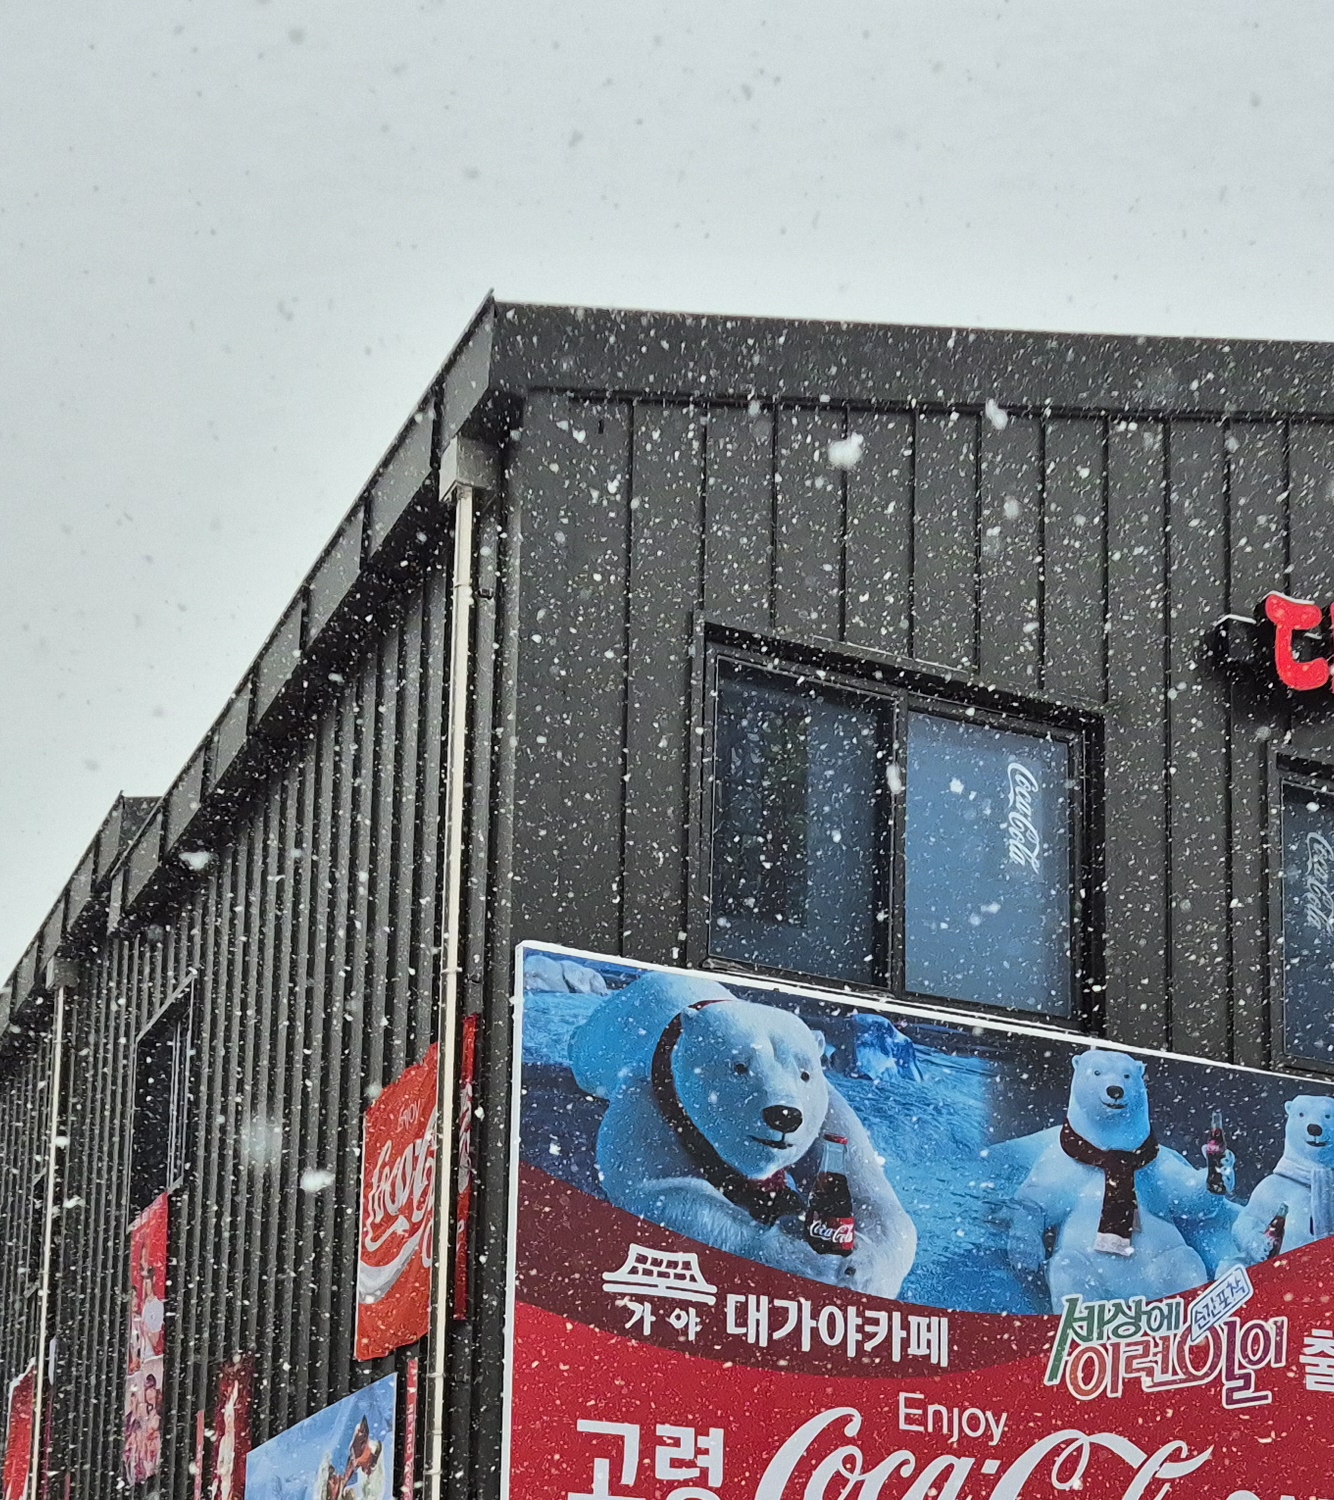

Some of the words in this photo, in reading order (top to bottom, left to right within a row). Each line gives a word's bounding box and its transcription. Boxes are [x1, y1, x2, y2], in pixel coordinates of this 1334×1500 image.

[1007, 762, 1040, 875] Coca-Cola
[1305, 831, 1334, 937] Coca-Cola
[727, 1295, 949, 1367] 대가야카페
[1044, 1295, 1184, 1386] 세상에
[898, 1392, 1008, 1445] Enjoy
